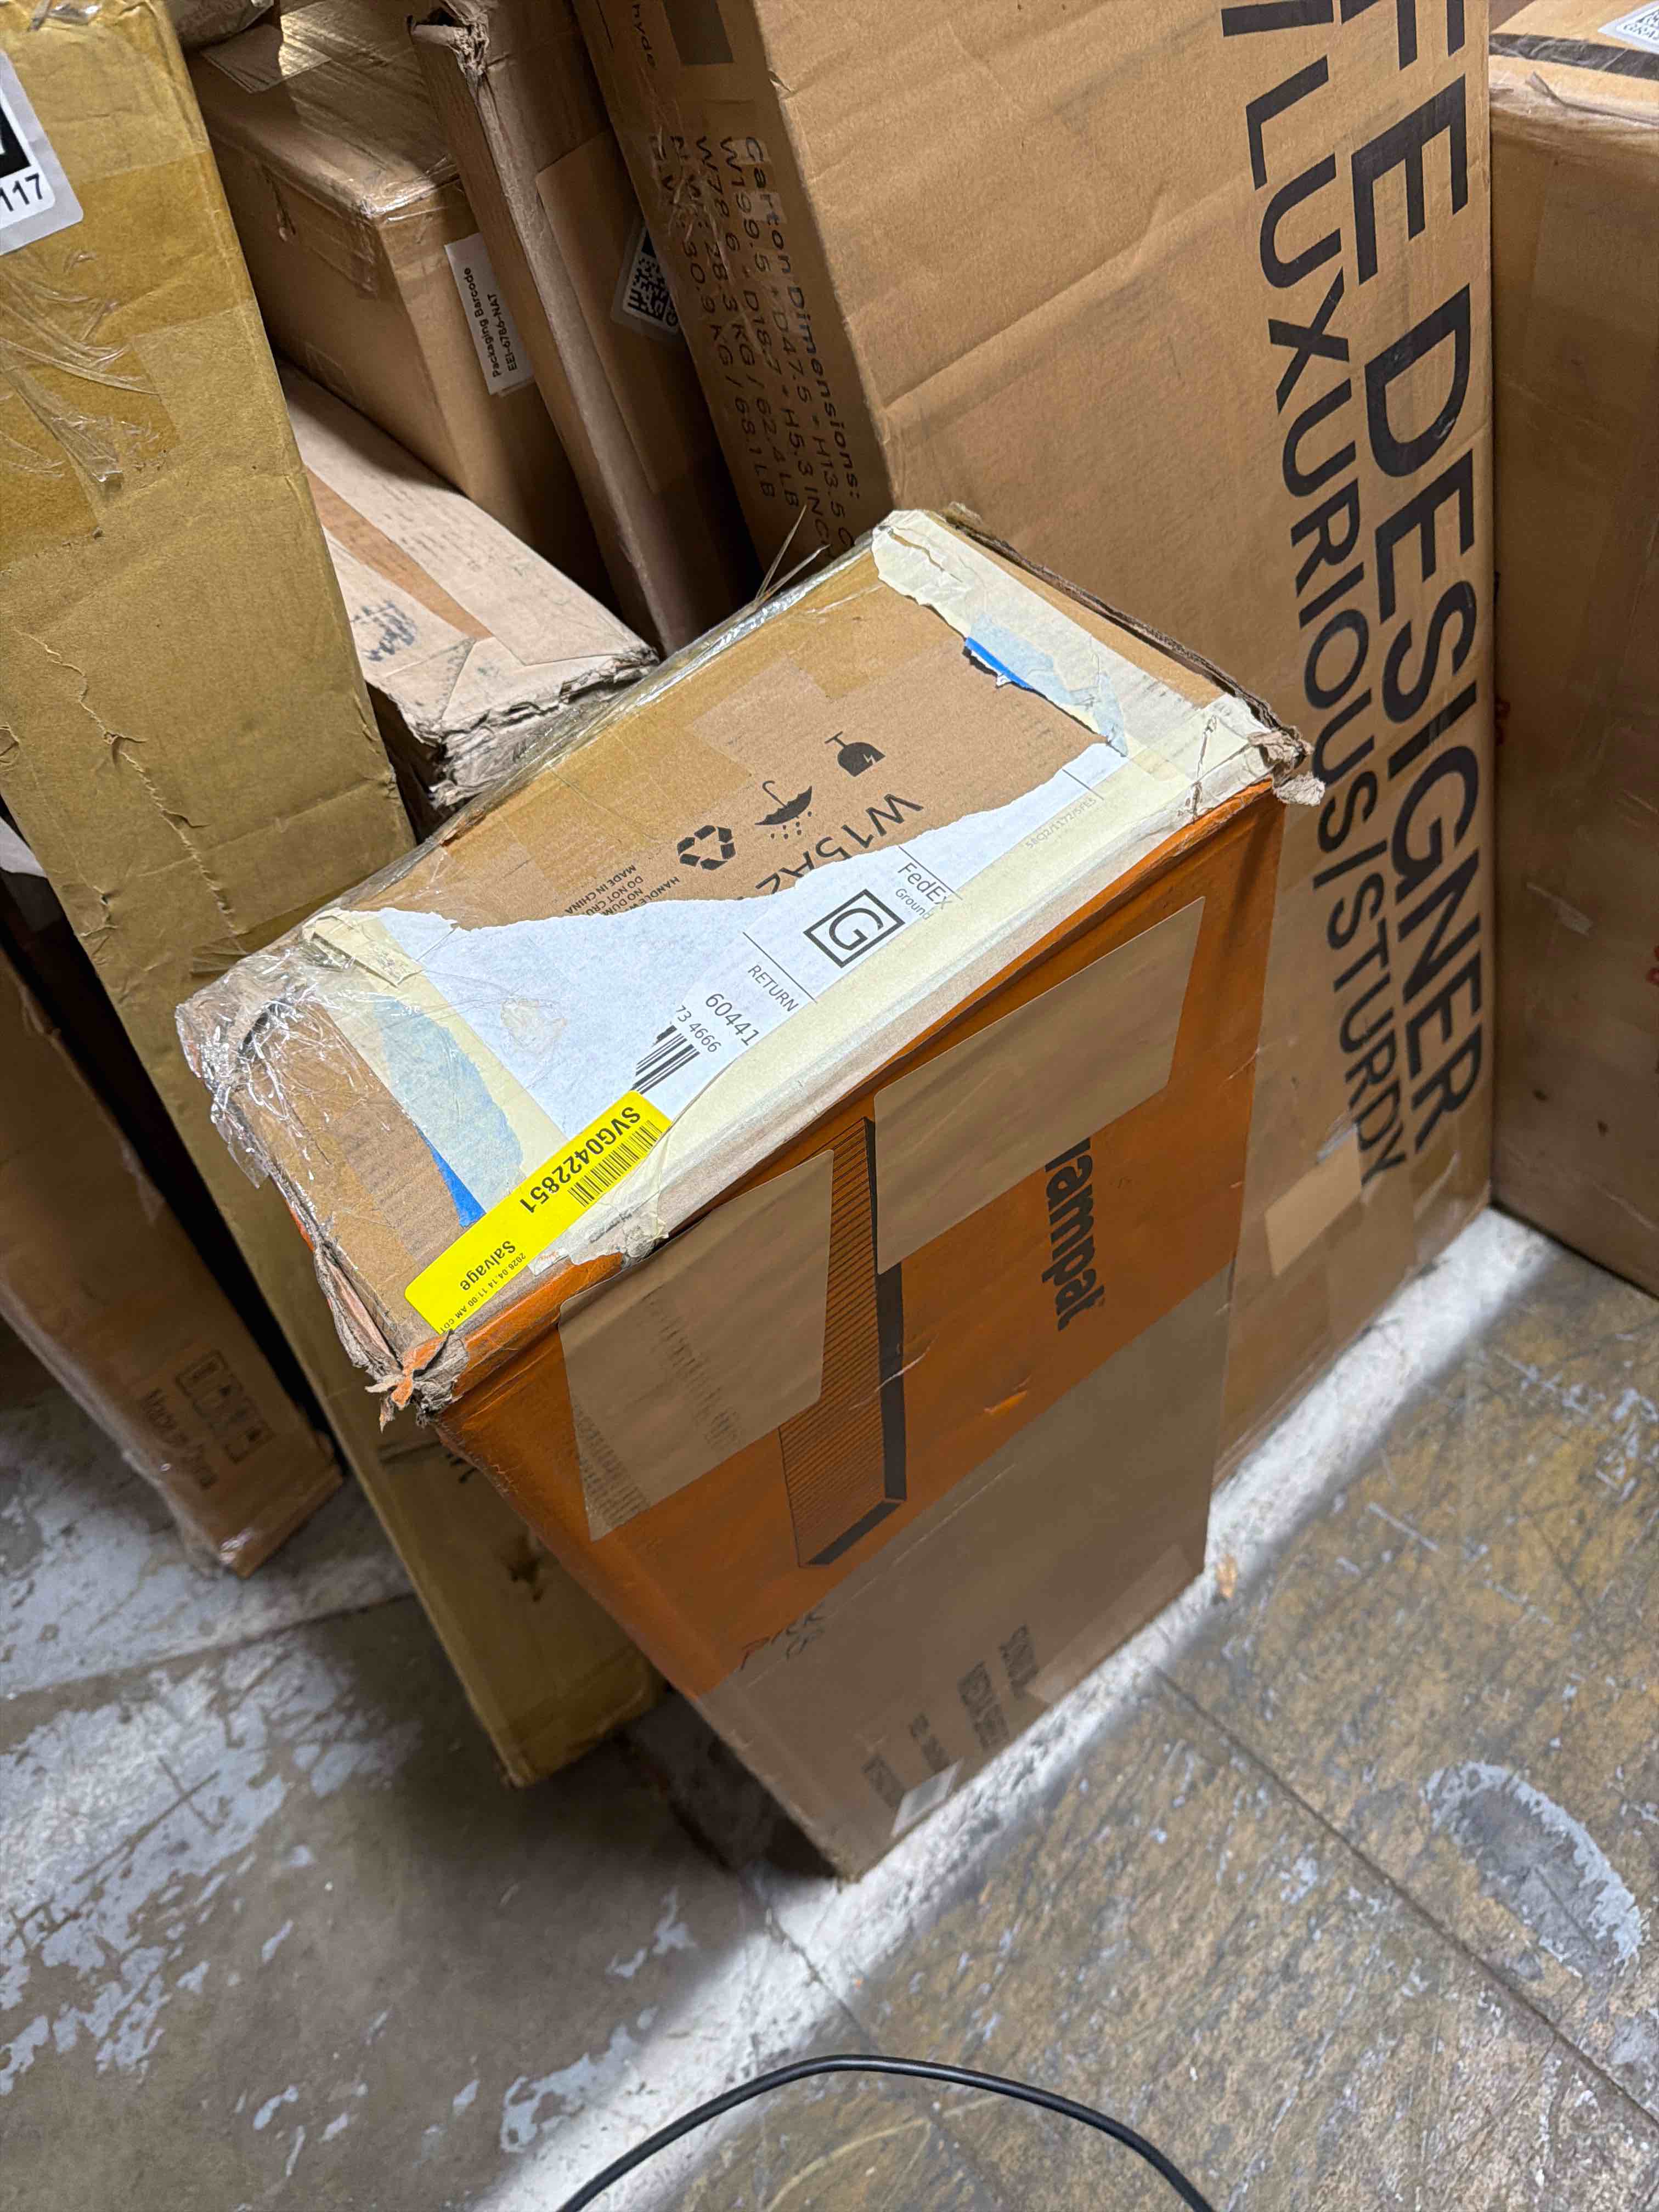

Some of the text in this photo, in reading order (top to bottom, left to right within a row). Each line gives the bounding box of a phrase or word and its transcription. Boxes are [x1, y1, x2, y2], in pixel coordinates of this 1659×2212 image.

[682, 240, 715, 313] 30.9
[464, 267, 501, 377] Packaging Barcode
[696, 136, 740, 251] W786
[781, 408, 813, 476] H5.3
[720, 137, 771, 273] W199.5
[772, 311, 812, 403] D47.5
[812, 436, 845, 518] H13.5
[746, 137, 860, 499] Carton Dimensions:
[731, 323, 755, 365] KG
[779, 472, 799, 507] LB
[1363, 283, 1482, 1154] DESIGNER
[565, 865, 636, 914] MADE IN CHINA
[586, 876, 644, 916] DO NOT CRU
[627, 888, 644, 901] NO
[639, 876, 680, 905] HANDLE
[895, 888, 934, 920] Ground
[898, 862, 952, 909] FedEx
[829, 908, 883, 951] G
[748, 964, 799, 1012] RETURN
[689, 1023, 721, 1052] 4666
[706, 994, 760, 1046] 60441
[520, 1107, 640, 1213] SVG0422851
[460, 1241, 516, 1290] Salvage
[488, 1253, 526, 1289] 2026.04.14
[455, 1306, 467, 1318] AM
[468, 1288, 488, 1307] 11:00
